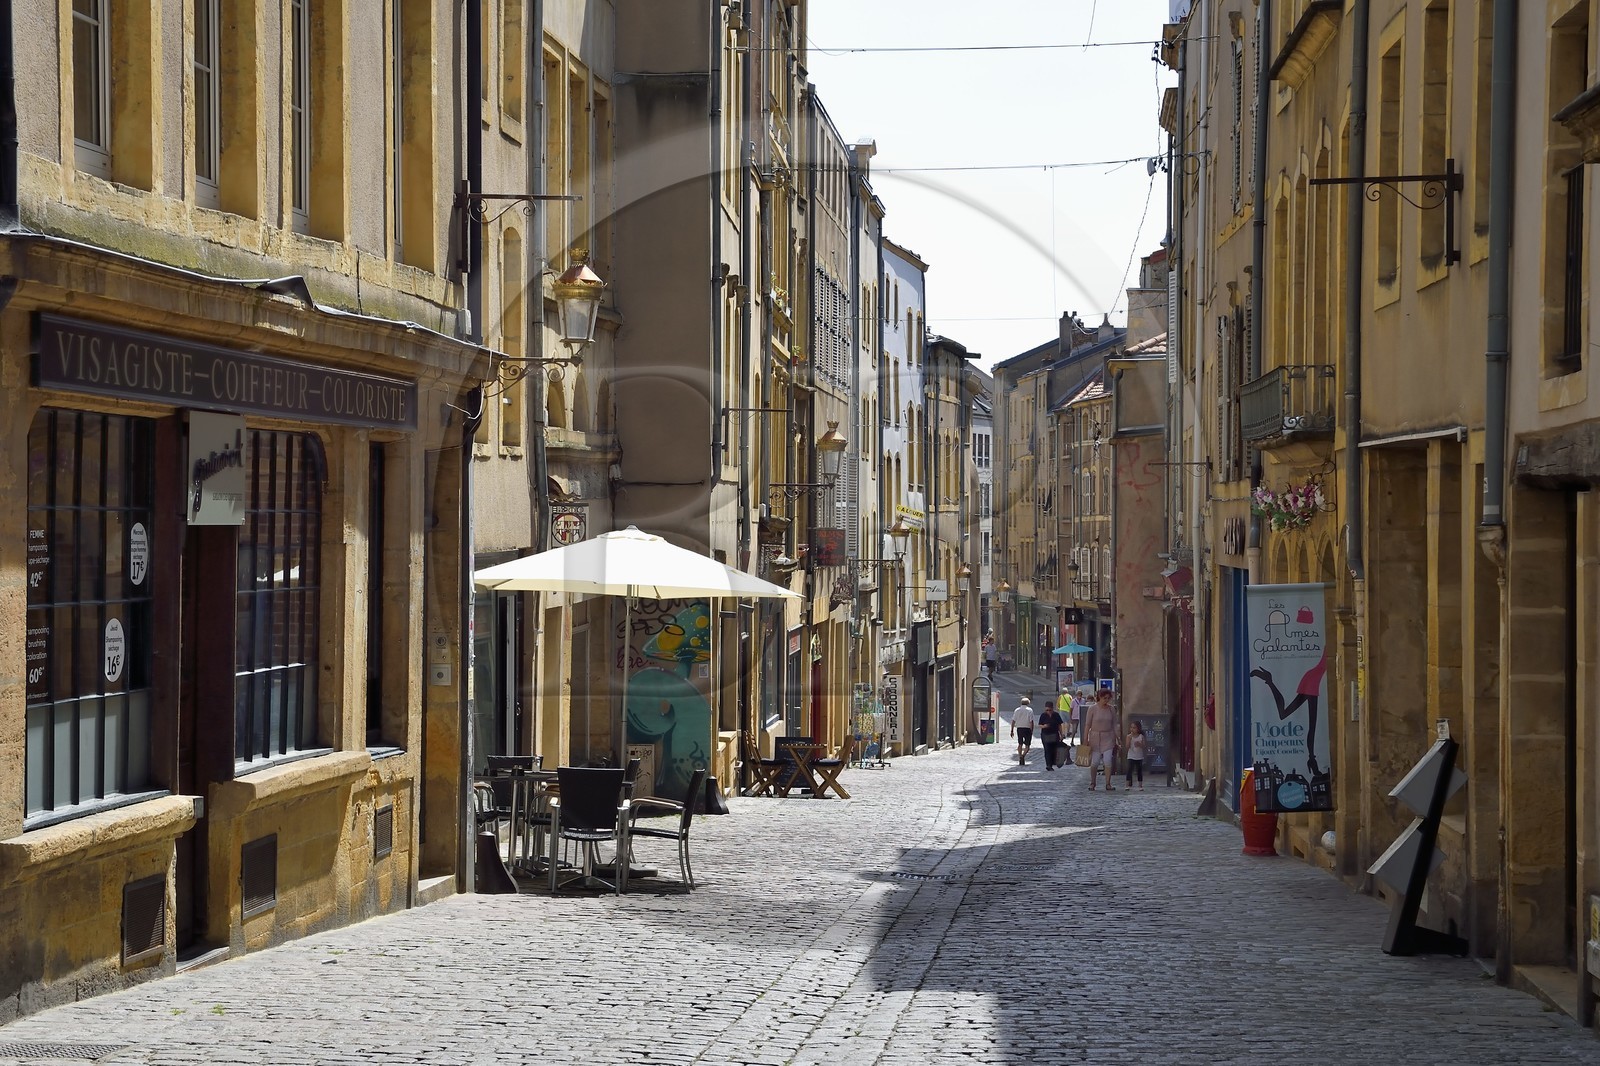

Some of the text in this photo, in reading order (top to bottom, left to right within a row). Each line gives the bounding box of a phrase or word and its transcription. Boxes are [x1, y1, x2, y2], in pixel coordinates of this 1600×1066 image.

[1268, 599, 1285, 609] Les
[1253, 637, 1321, 660] Galantes
[888, 677, 898, 740] CORDONNERIE
[1255, 721, 1304, 738] Mode
[1255, 738, 1305, 748] Chapeaux
